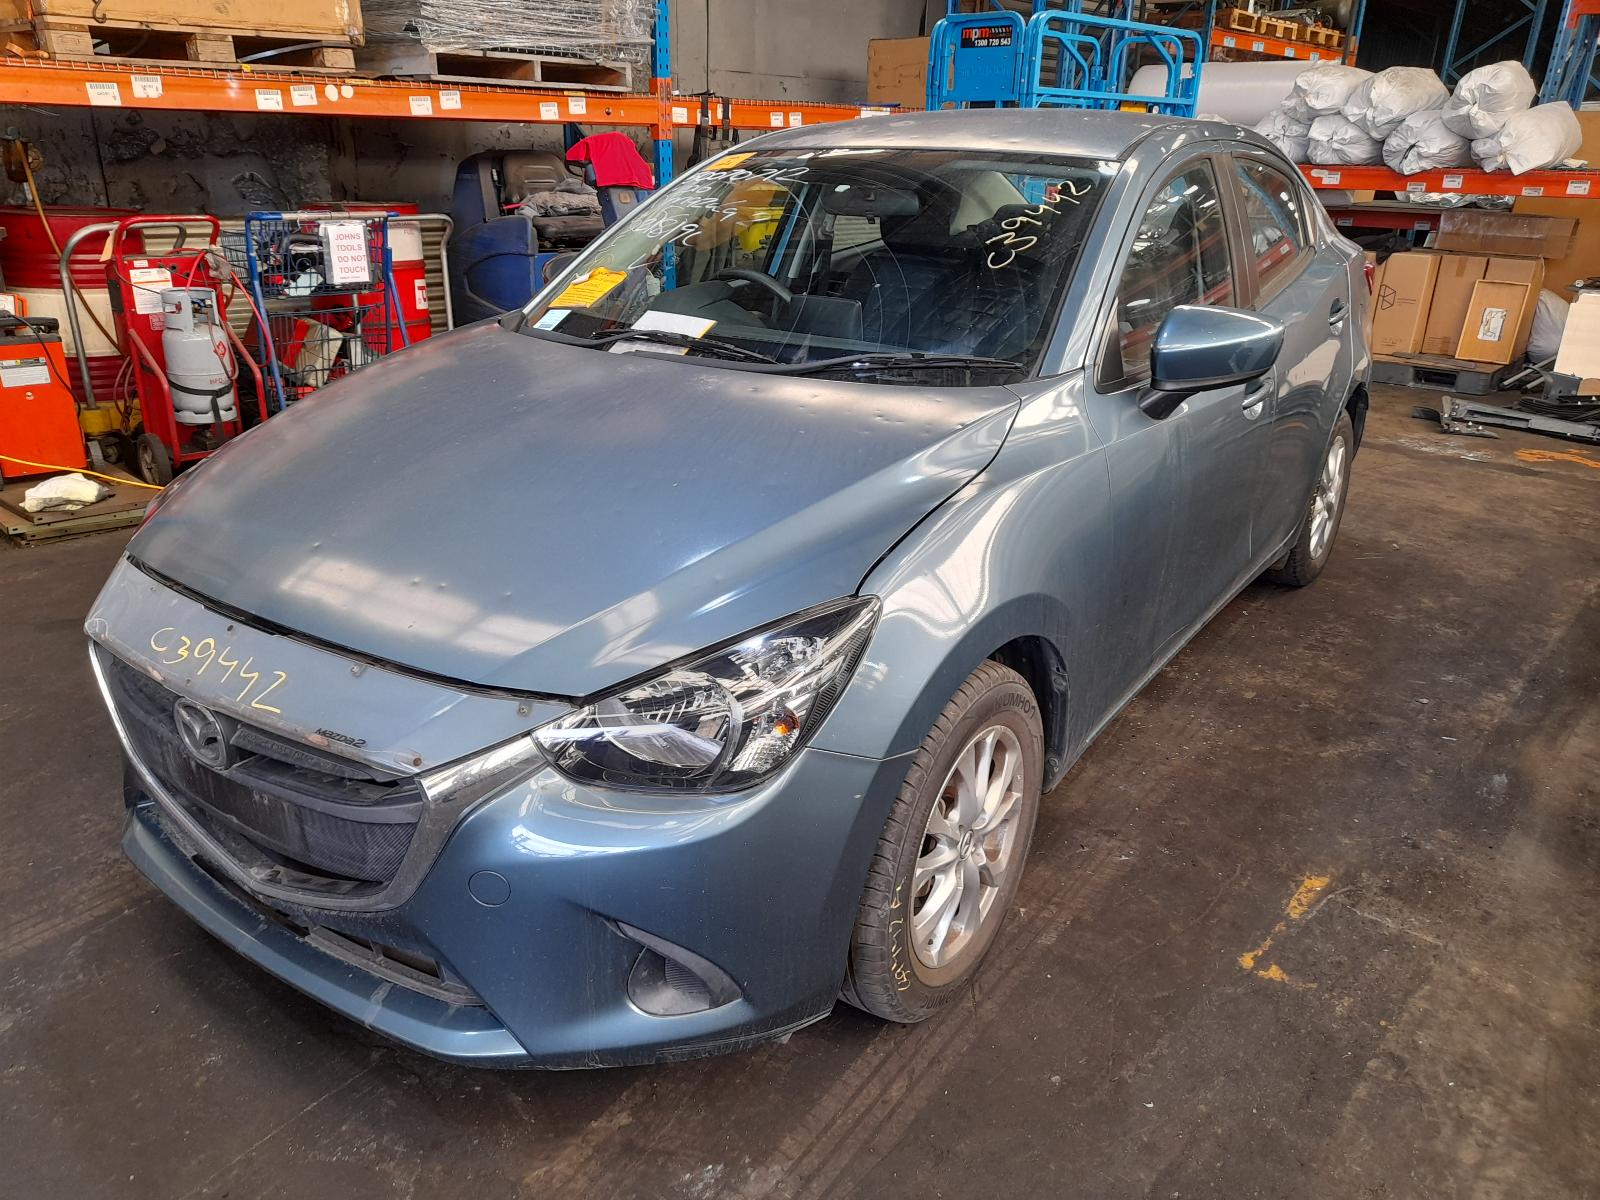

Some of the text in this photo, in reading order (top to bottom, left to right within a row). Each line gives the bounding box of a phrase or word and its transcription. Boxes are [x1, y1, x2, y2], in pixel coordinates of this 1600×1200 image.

[963, 27, 989, 41] mpm
[974, 37, 1012, 47] 1300 720 543
[985, 180, 1092, 269] C39442
[335, 232, 361, 241] JOHNS
[335, 244, 363, 252] TOOLS
[337, 254, 367, 263] DO NOT
[338, 266, 366, 274] TOUCH
[150, 626, 287, 714] C39442
